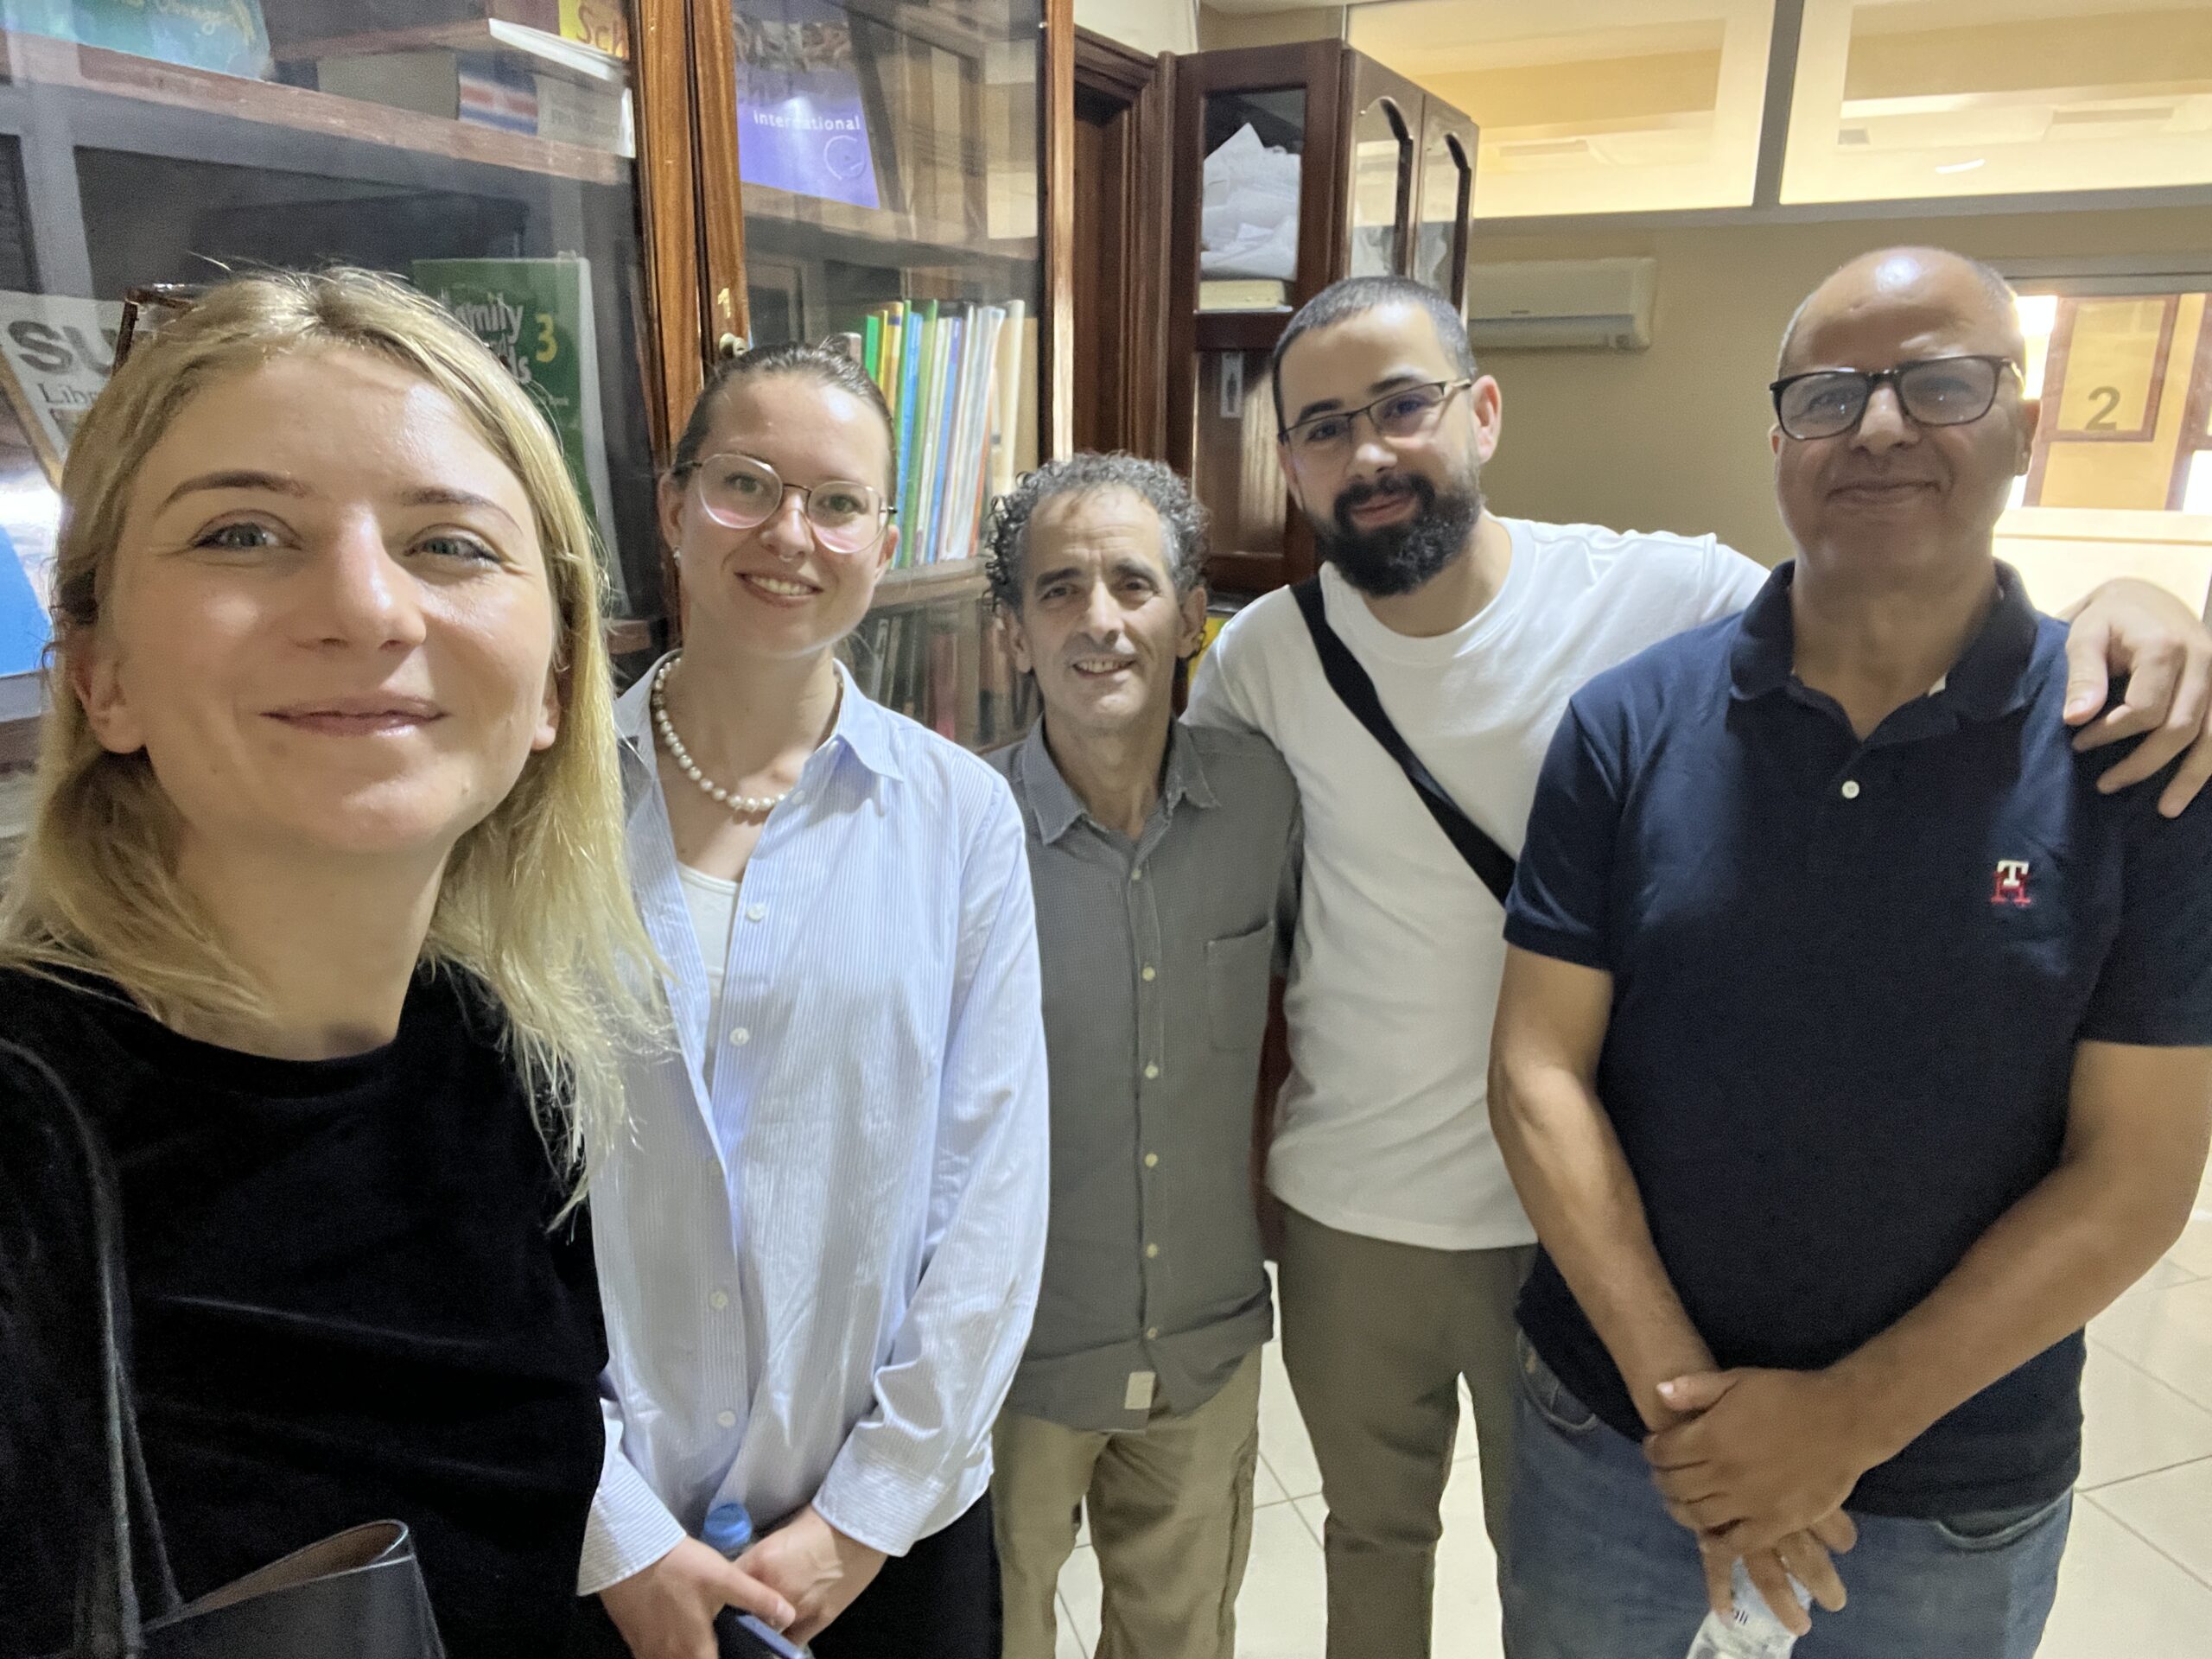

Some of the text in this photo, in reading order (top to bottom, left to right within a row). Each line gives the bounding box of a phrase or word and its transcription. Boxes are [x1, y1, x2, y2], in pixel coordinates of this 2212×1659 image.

[753, 110, 861, 131] Interational
[8, 320, 118, 379] SU
[536, 314, 557, 362] 3
[37, 382, 99, 405] Libr
[2085, 387, 2120, 431] 2
